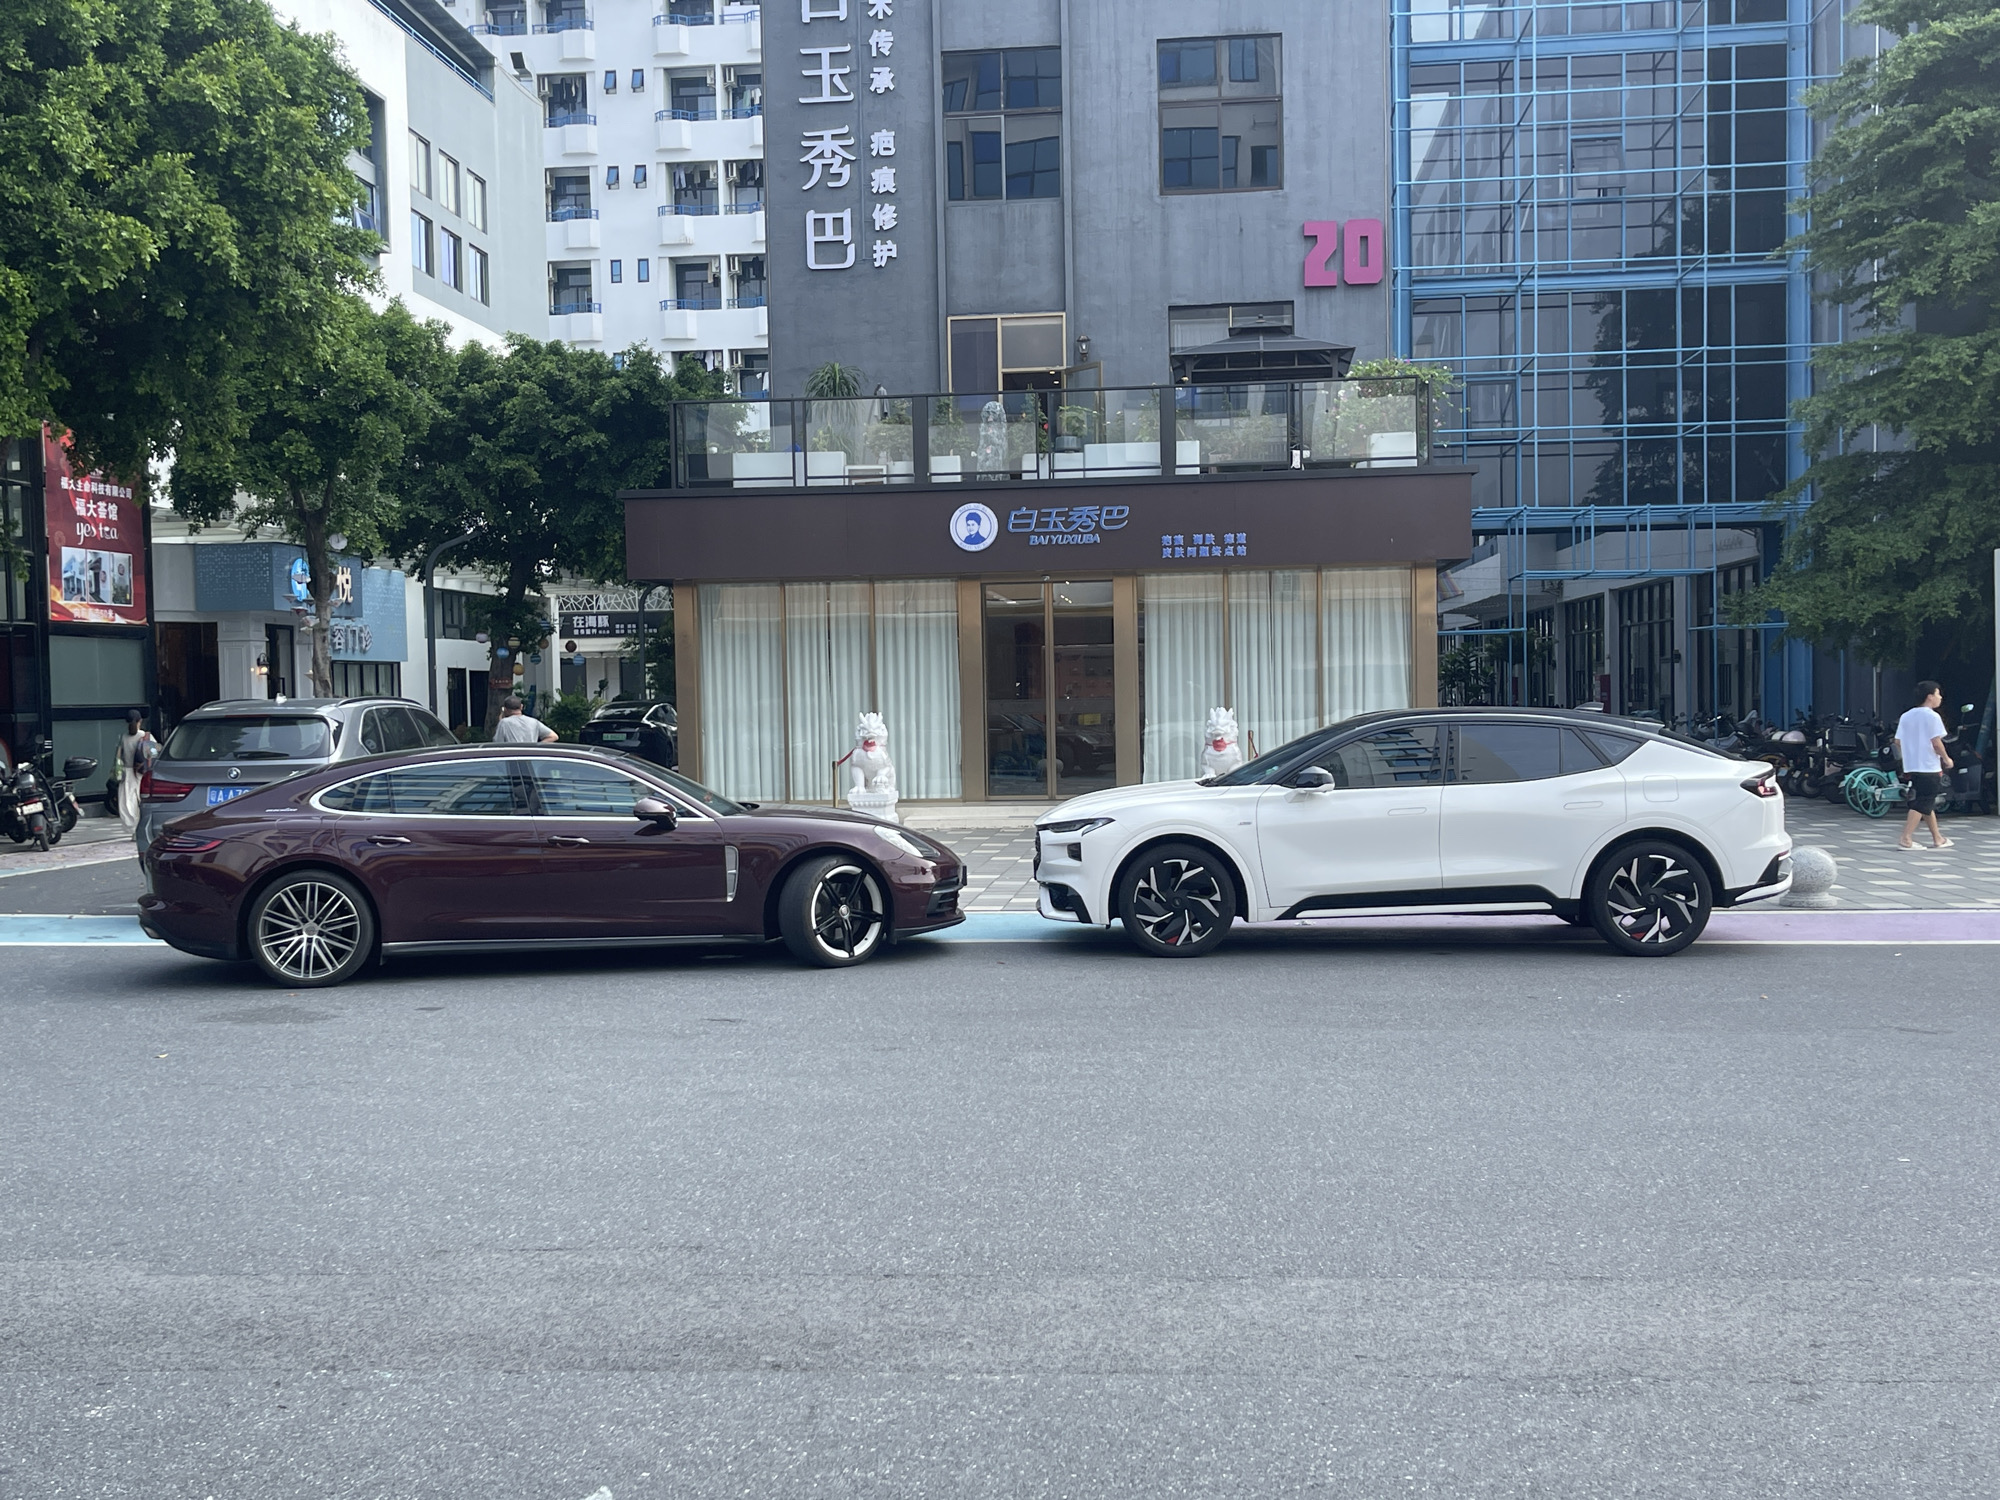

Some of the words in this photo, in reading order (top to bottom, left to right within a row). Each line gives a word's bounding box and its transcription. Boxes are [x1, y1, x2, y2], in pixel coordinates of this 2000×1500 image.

[870, 128, 898, 268] 疤痕修护
[1303, 218, 1384, 287] 20
[75, 522, 97, 546] yes
[1007, 504, 1130, 533] 白玉秀巴
